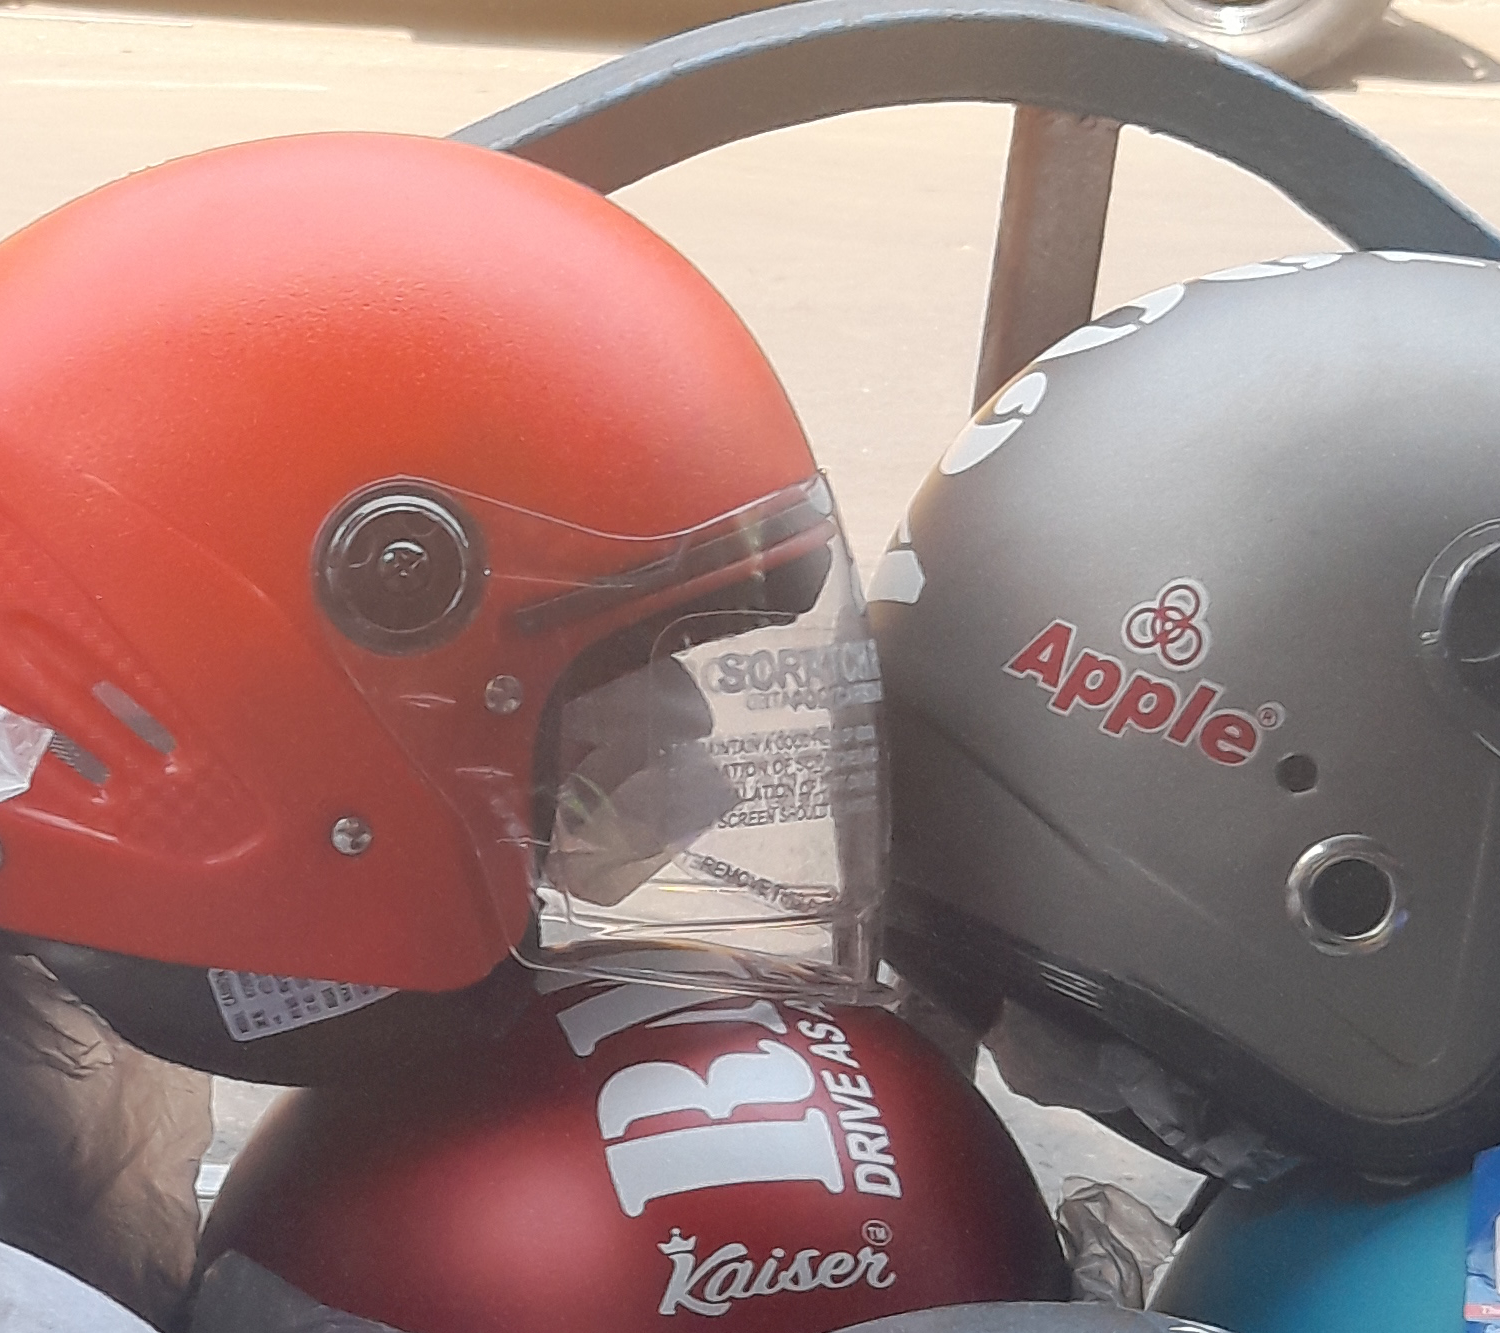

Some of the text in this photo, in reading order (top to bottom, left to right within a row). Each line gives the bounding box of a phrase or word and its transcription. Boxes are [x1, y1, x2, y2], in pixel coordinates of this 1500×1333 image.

[1001, 618, 1262, 767] Apple
[797, 1017, 862, 1069] AS
[820, 1067, 902, 1200] DRIVE
[656, 1240, 898, 1318] Kaiser
